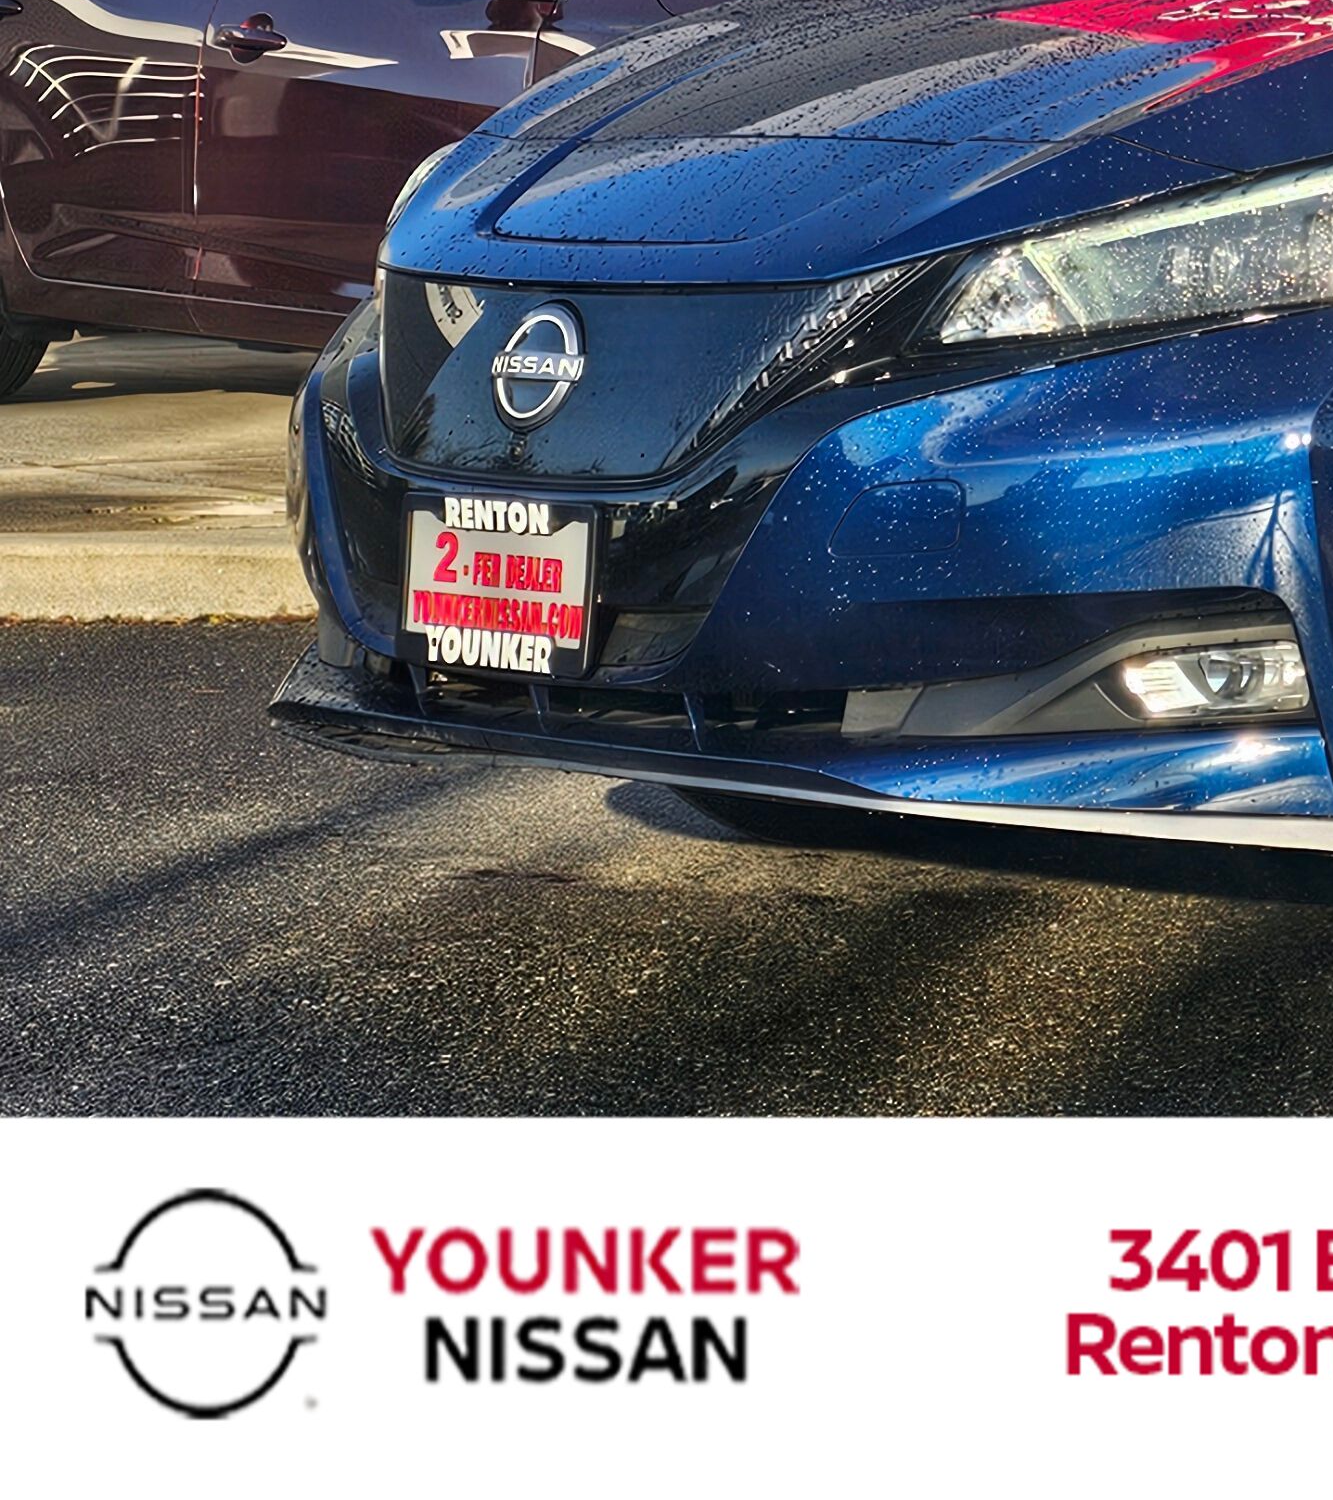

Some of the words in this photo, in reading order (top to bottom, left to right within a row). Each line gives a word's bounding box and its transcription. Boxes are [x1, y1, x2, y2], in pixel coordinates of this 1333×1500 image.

[492, 355, 581, 379] NISSAN
[444, 497, 550, 535] RENTON
[424, 624, 551, 674] YOUNKER
